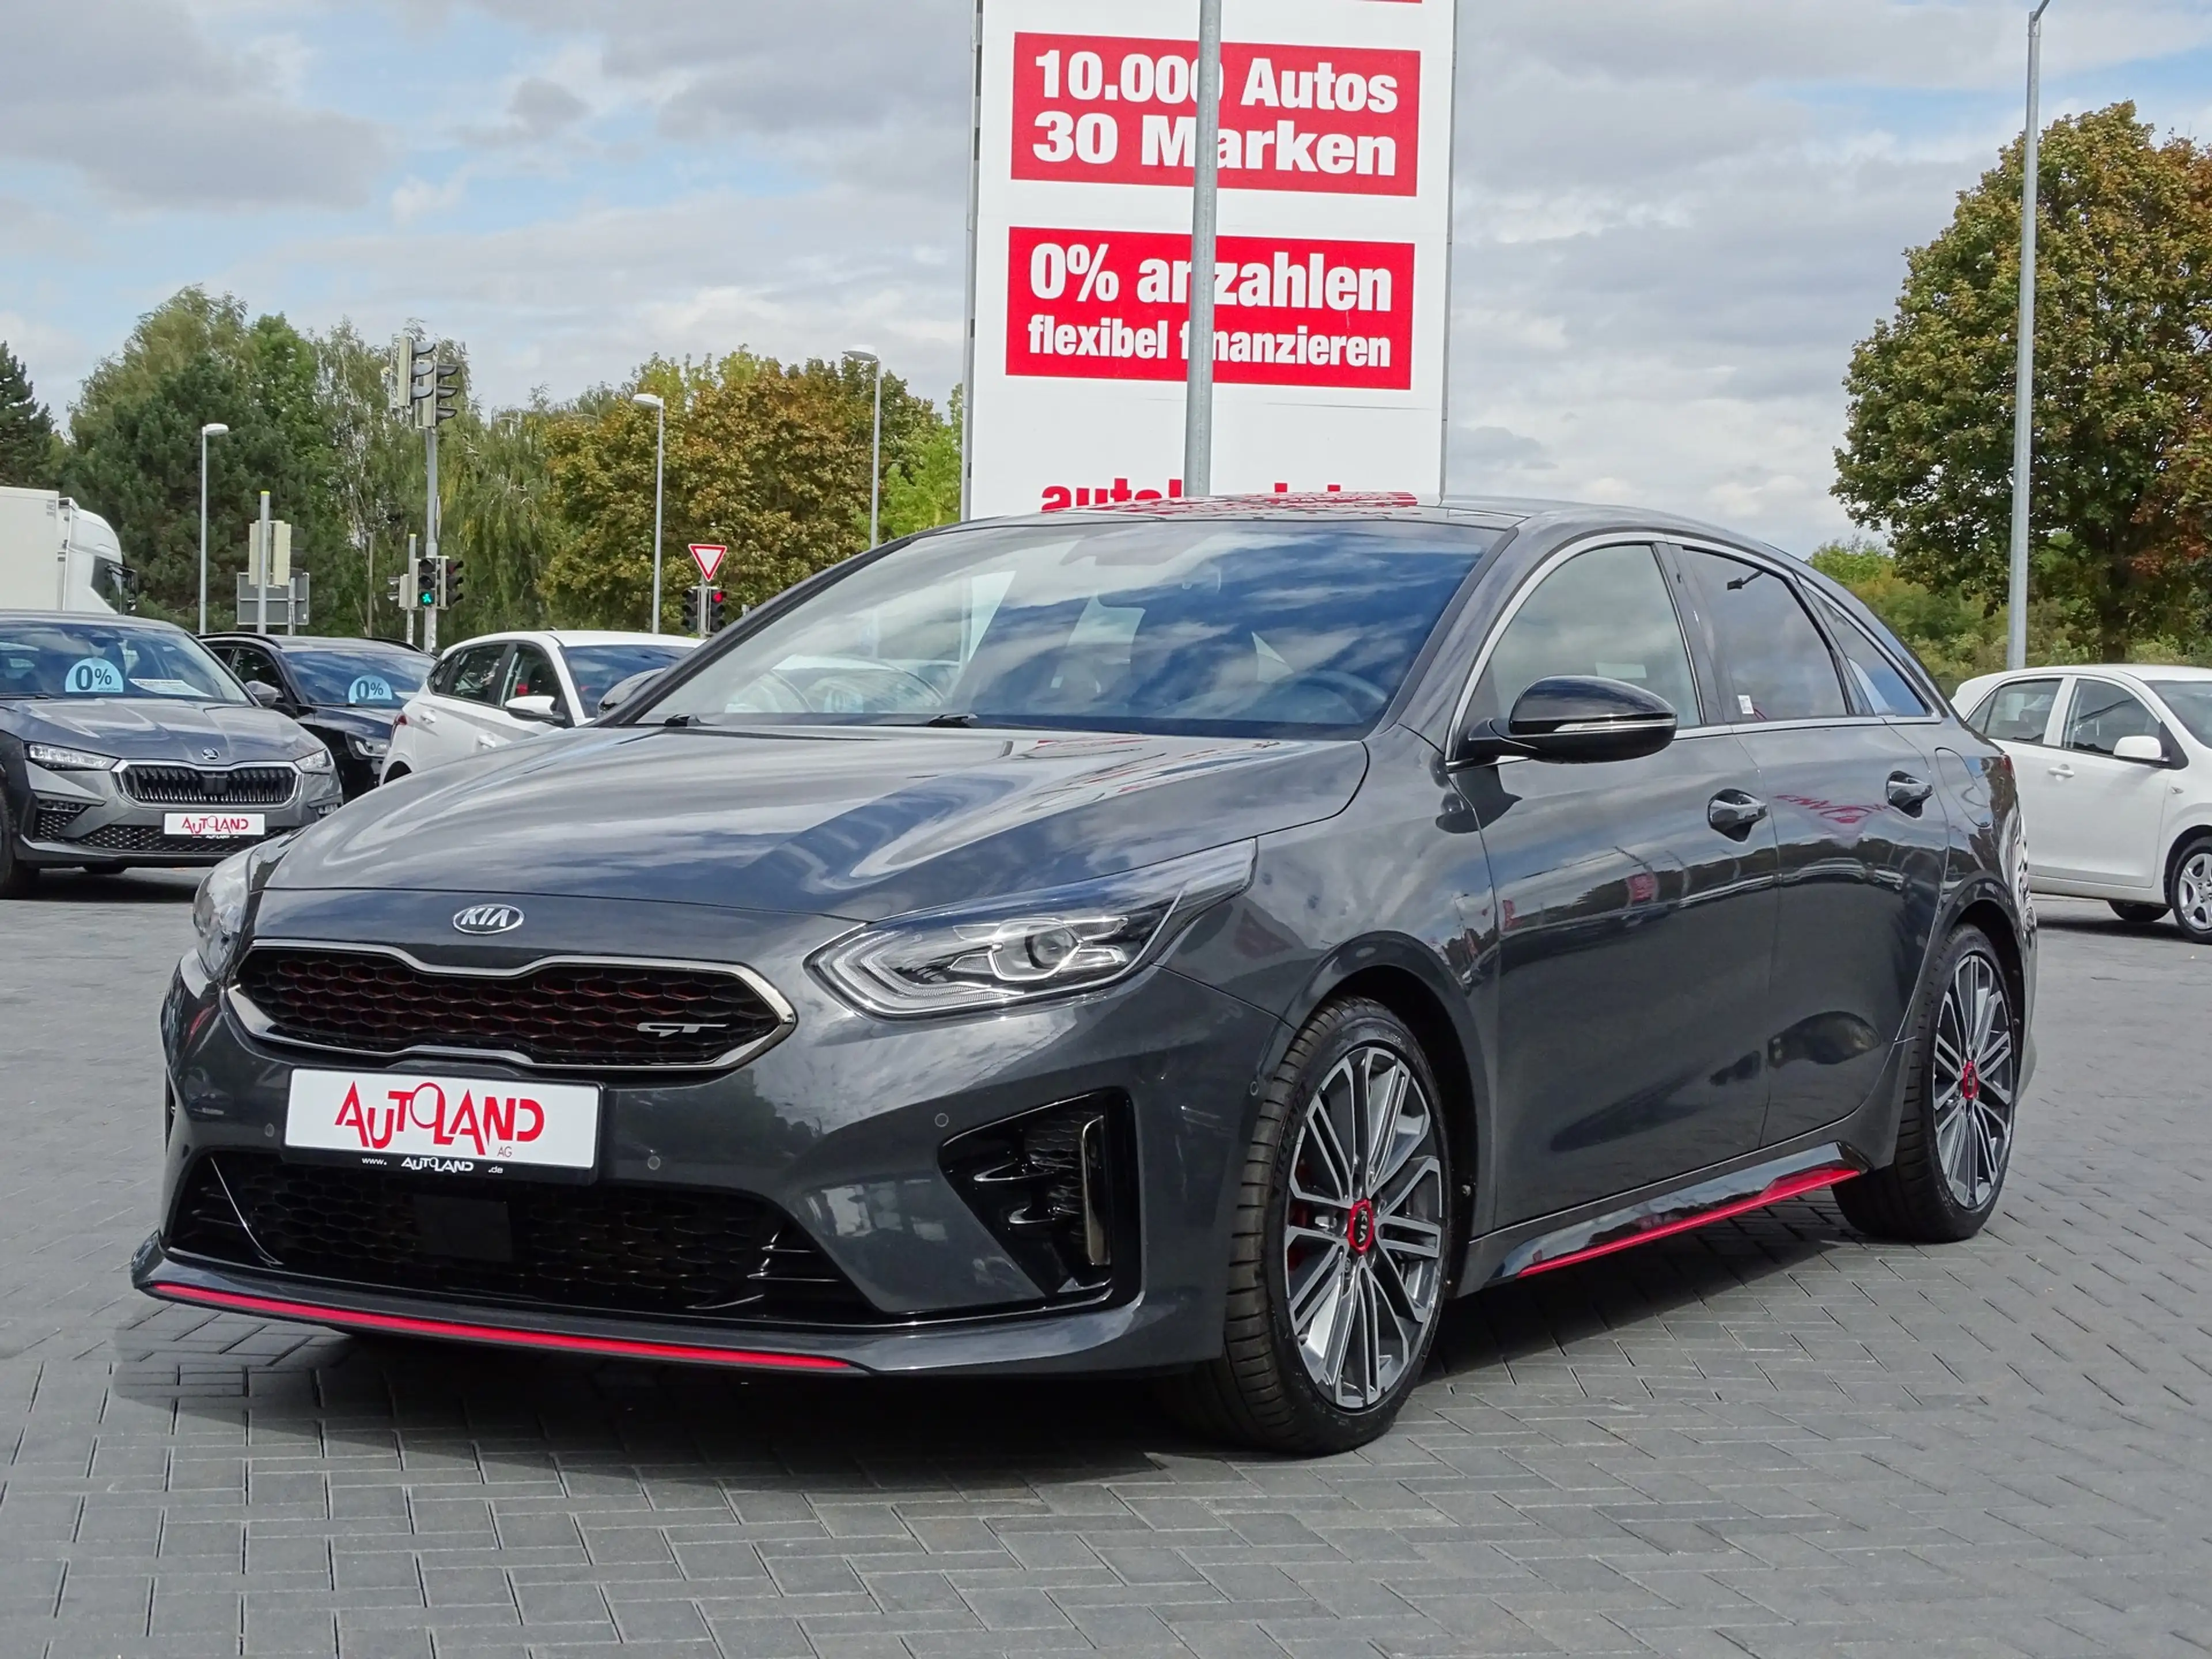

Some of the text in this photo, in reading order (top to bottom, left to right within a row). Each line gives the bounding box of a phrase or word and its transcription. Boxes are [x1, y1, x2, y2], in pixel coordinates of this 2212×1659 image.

[1240, 57, 1398, 113] Autos
[1032, 111, 1396, 176] 30 Marken
[1031, 243, 1119, 302] 0%
[1028, 314, 1391, 368] flexibel fnanzieren
[75, 665, 112, 691] 0%
[356, 680, 384, 698] 0%
[181, 815, 249, 835] AUTOLAND
[460, 907, 510, 927] KIA
[637, 1022, 729, 1037] GT
[334, 1080, 545, 1156] AUTOLAND
[362, 1156, 504, 1174] www. AUTOLAND .de
[496, 1146, 513, 1158] AG
[1358, 1209, 1369, 1243] KIA
